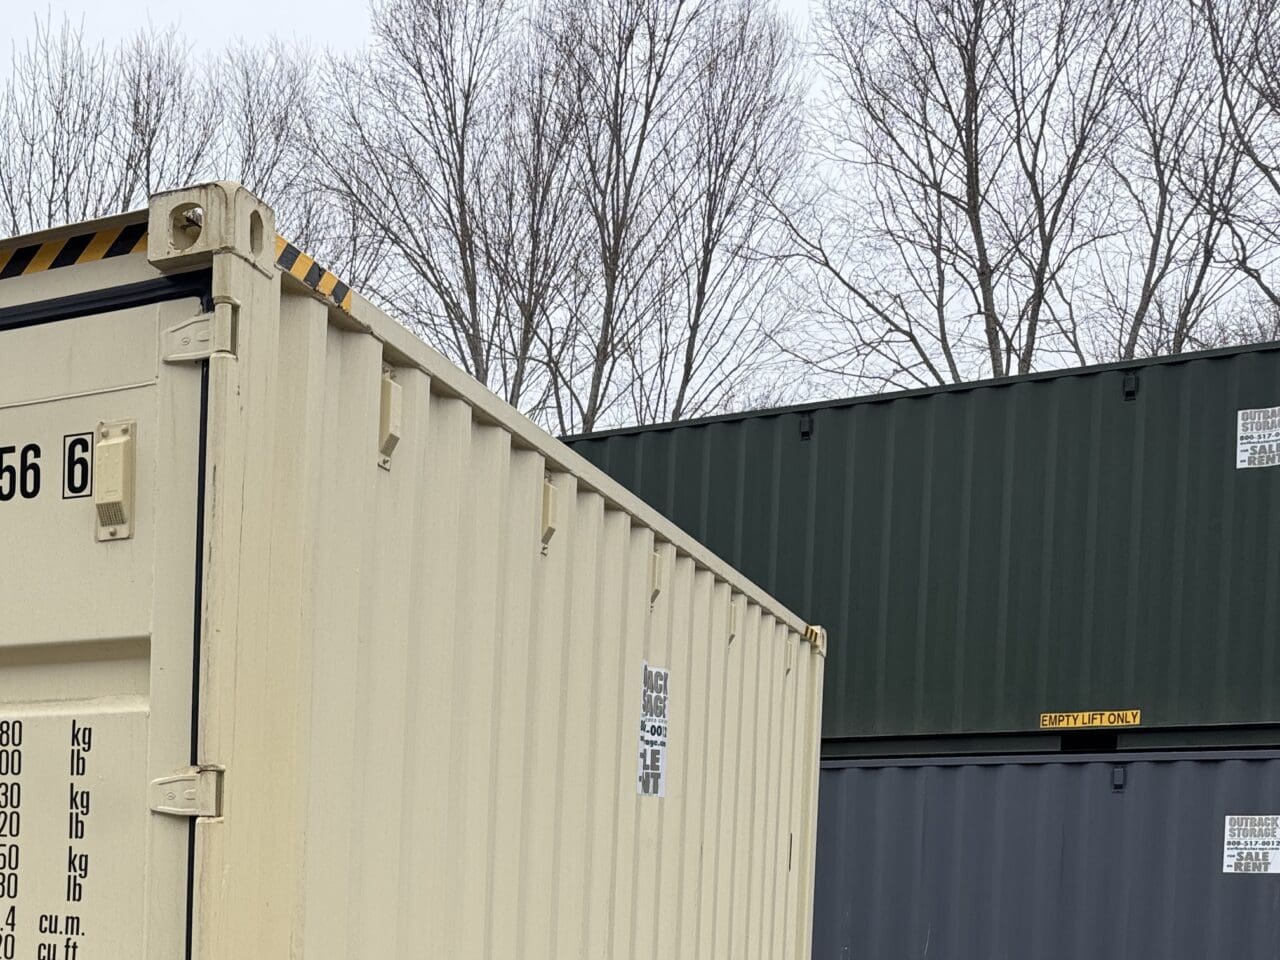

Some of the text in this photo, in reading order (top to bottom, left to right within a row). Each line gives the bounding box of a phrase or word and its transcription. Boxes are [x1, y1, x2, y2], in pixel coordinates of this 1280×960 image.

[68, 438, 89, 494] 6
[1042, 711, 1138, 726] EMPTY LIFT ONLY
[71, 719, 92, 752] kg
[70, 749, 85, 776] lb
[70, 782, 90, 815] kg
[69, 812, 84, 839] lb
[68, 846, 88, 878] kg
[1234, 861, 1271, 872] RENT
[1236, 852, 1270, 862] SALE
[66, 875, 82, 902] lb
[39, 914, 85, 936] cu.m.
